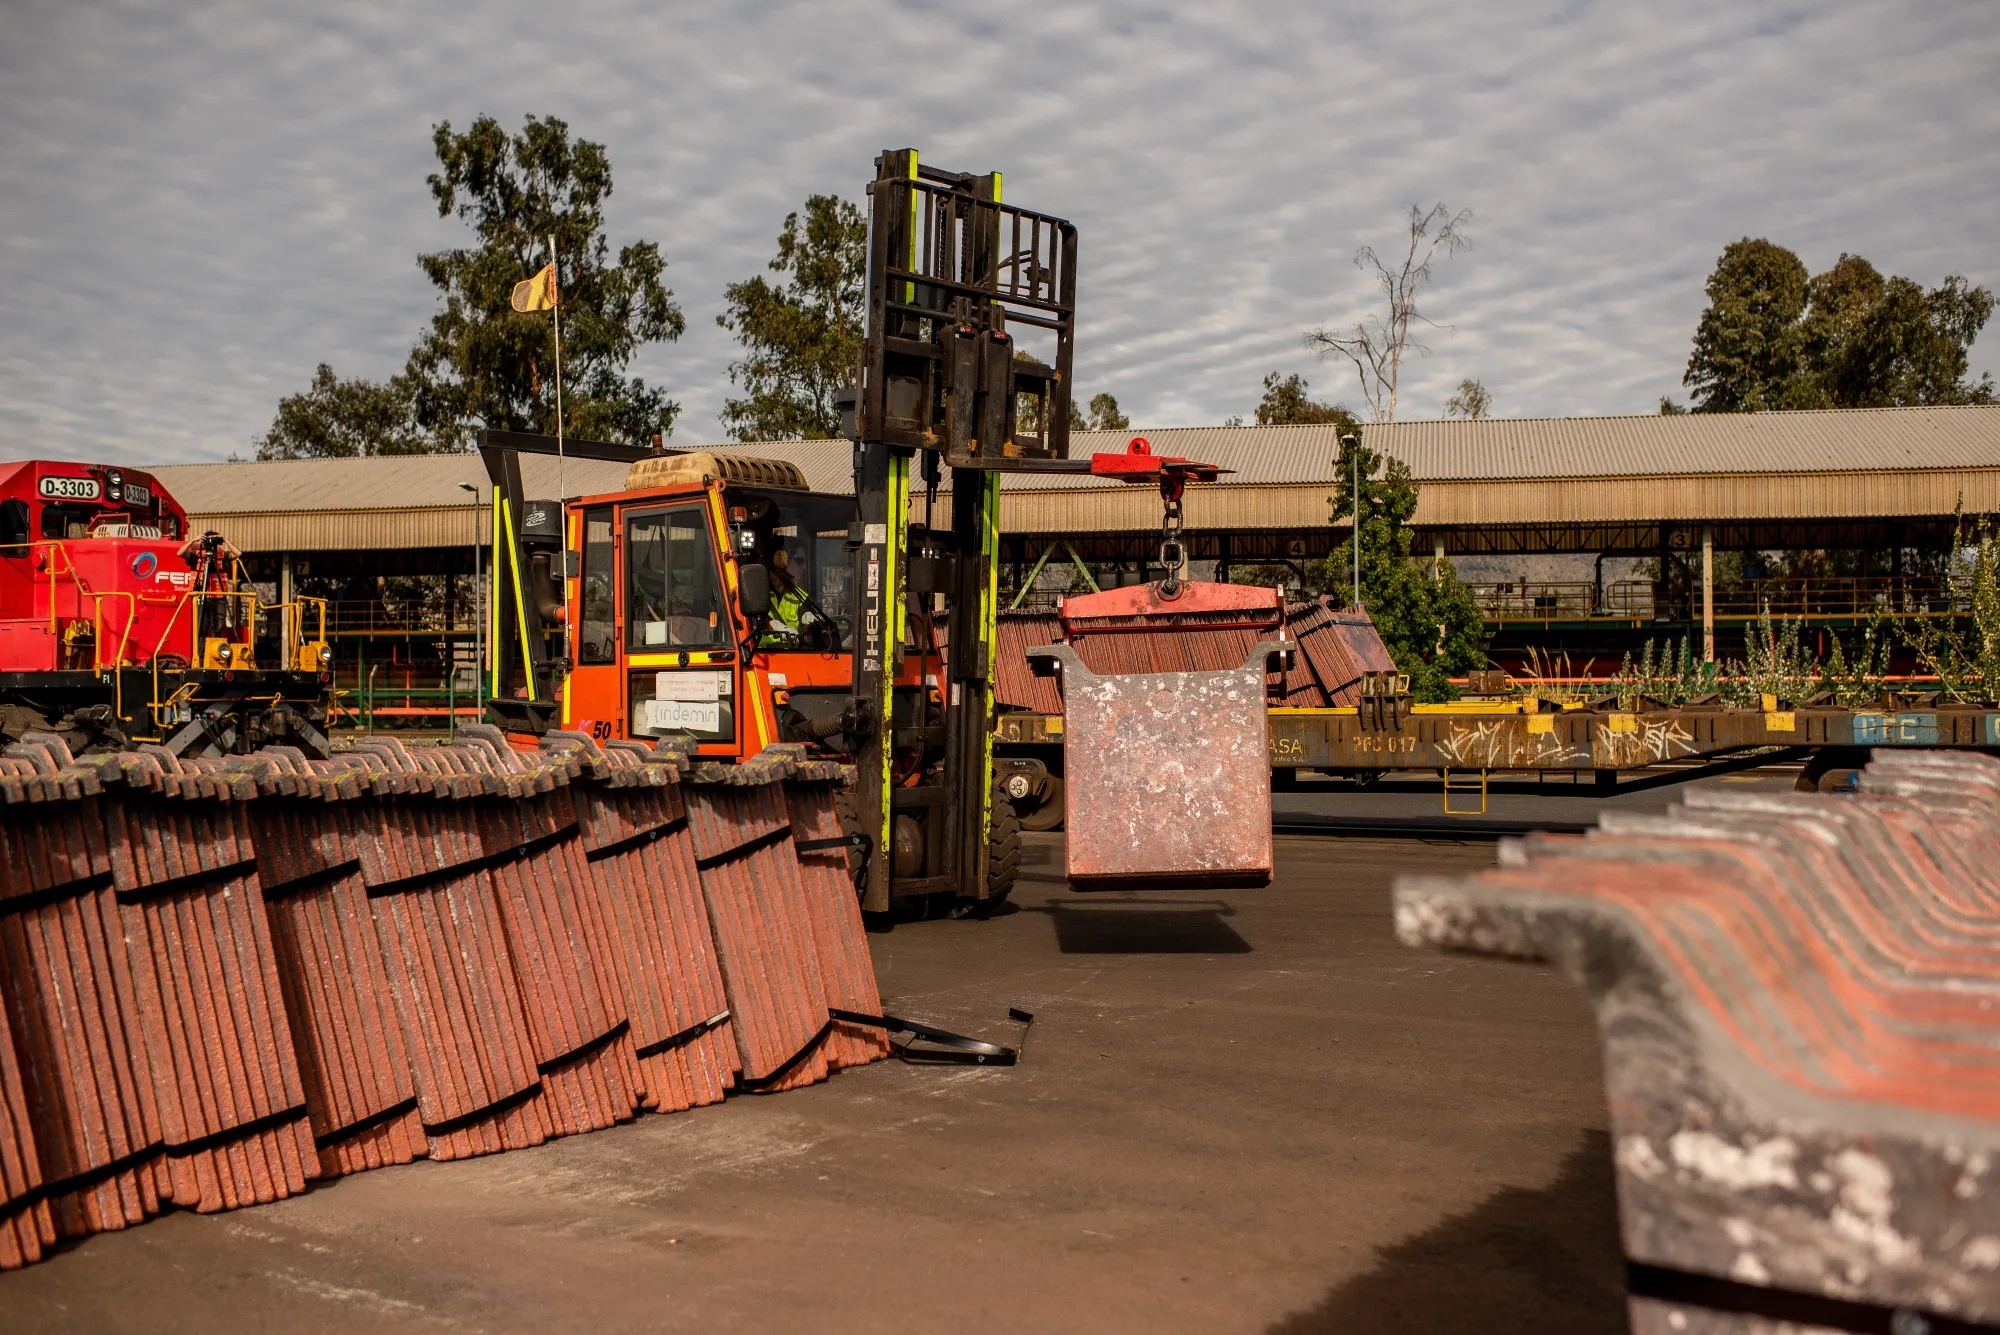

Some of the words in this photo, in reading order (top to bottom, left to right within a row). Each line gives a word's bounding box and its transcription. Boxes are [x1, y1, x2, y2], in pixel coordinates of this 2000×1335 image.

[45, 480, 94, 497] D-3303
[125, 485, 147, 504] D-3303
[1291, 541, 1302, 555] 4
[1675, 534, 1686, 547] 3
[592, 720, 612, 740] 50
[1388, 736, 1417, 753] 017
